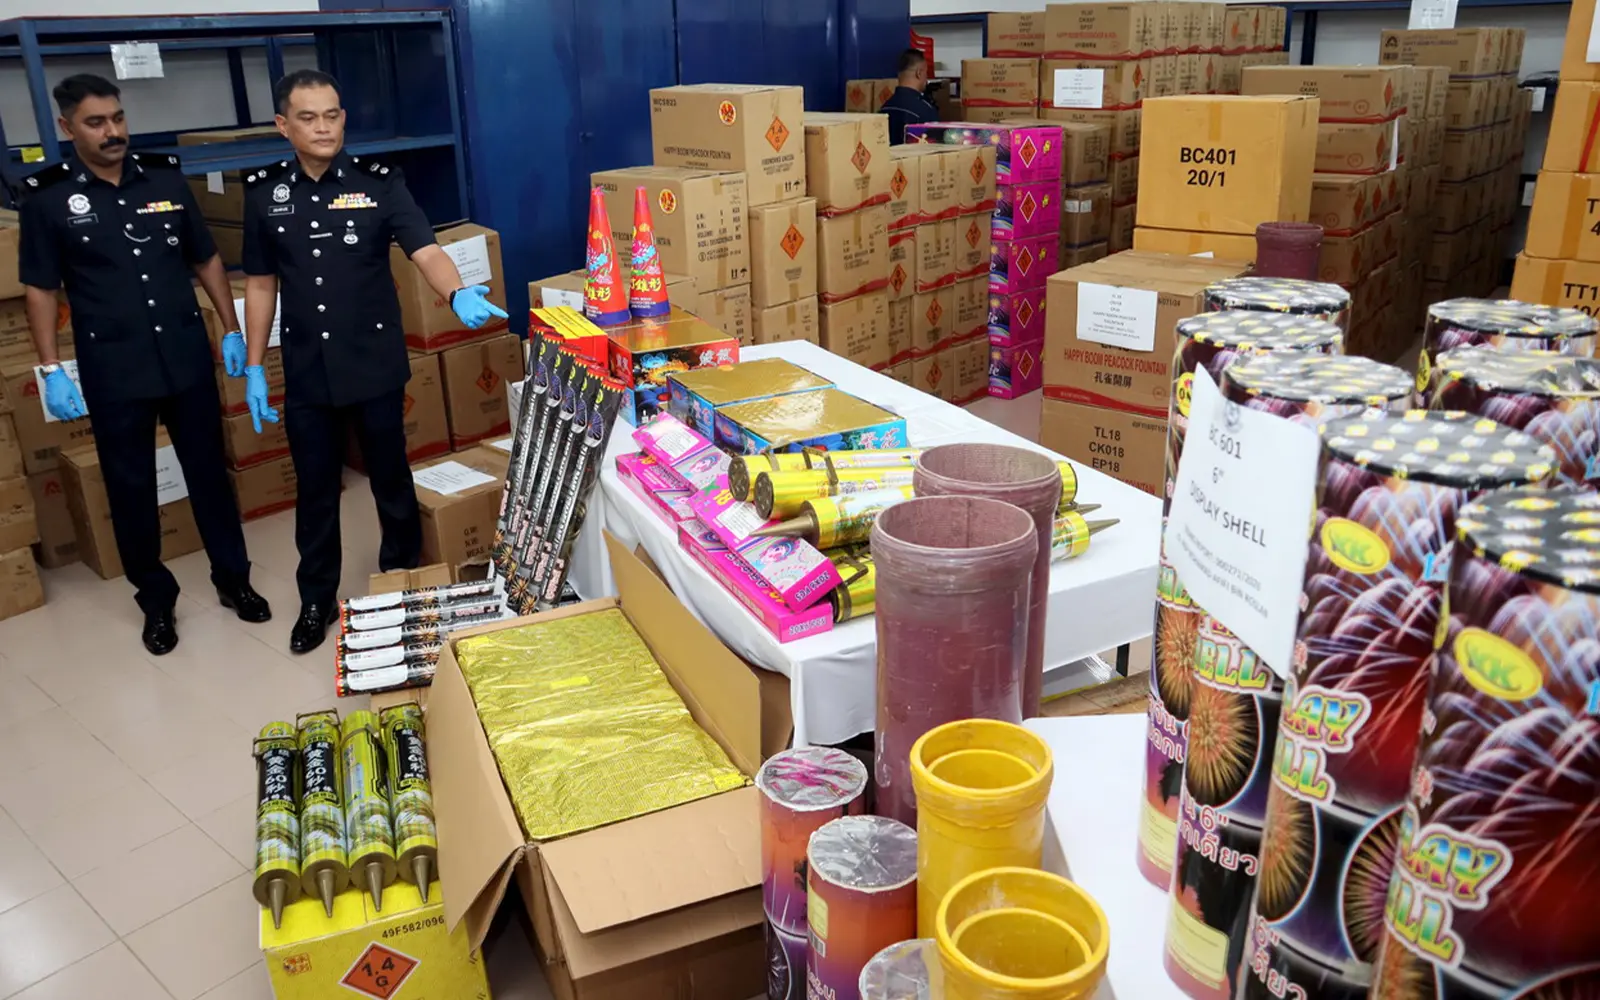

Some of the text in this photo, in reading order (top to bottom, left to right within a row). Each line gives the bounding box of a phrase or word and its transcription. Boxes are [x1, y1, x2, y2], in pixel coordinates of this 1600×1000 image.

[1180, 147, 1236, 166] BC401
[1187, 170, 1226, 187] 20/1
[1064, 348, 1168, 376] HAPPY BOOM PEACOCK FOUNTAIN
[1094, 426, 1121, 441] TL18
[1088, 442, 1124, 458] CK018
[1220, 434, 1242, 460] 601
[1092, 458, 1120, 472] EP18
[1222, 510, 1266, 548] SHELL
[362, 956, 394, 978] 1.4
[376, 975, 389, 988] G
